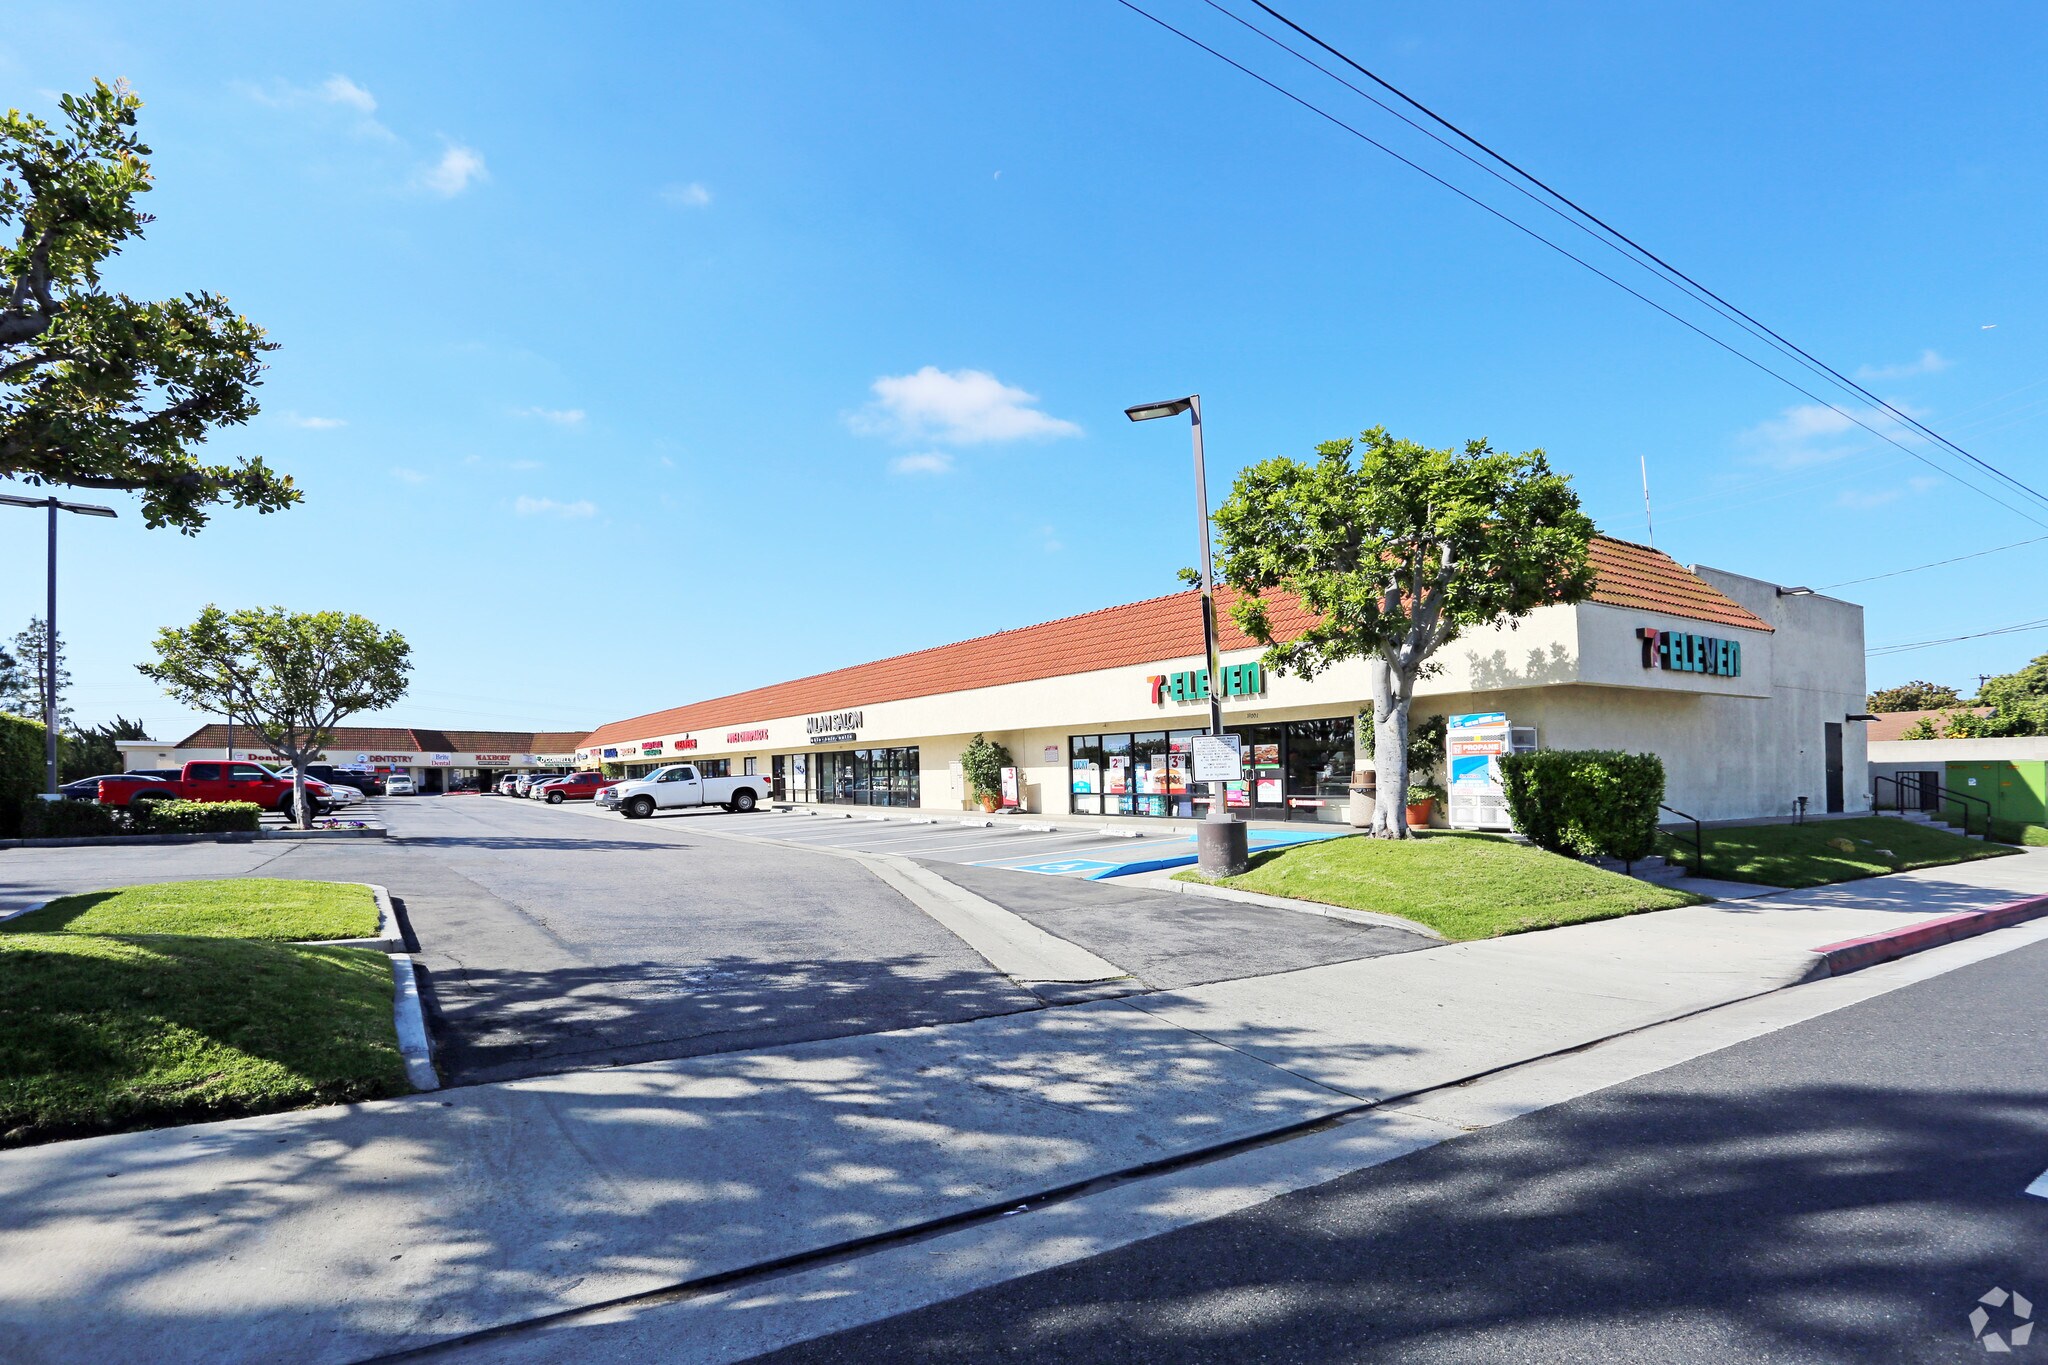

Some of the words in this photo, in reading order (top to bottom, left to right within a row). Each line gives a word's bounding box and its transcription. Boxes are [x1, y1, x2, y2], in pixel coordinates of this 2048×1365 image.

[807, 715, 833, 734] MILAN
[833, 711, 863, 732] SALON
[1462, 743, 1500, 751] PROPANE
[369, 755, 413, 763] DENTISTRY
[1073, 760, 1089, 770] LUCKY
